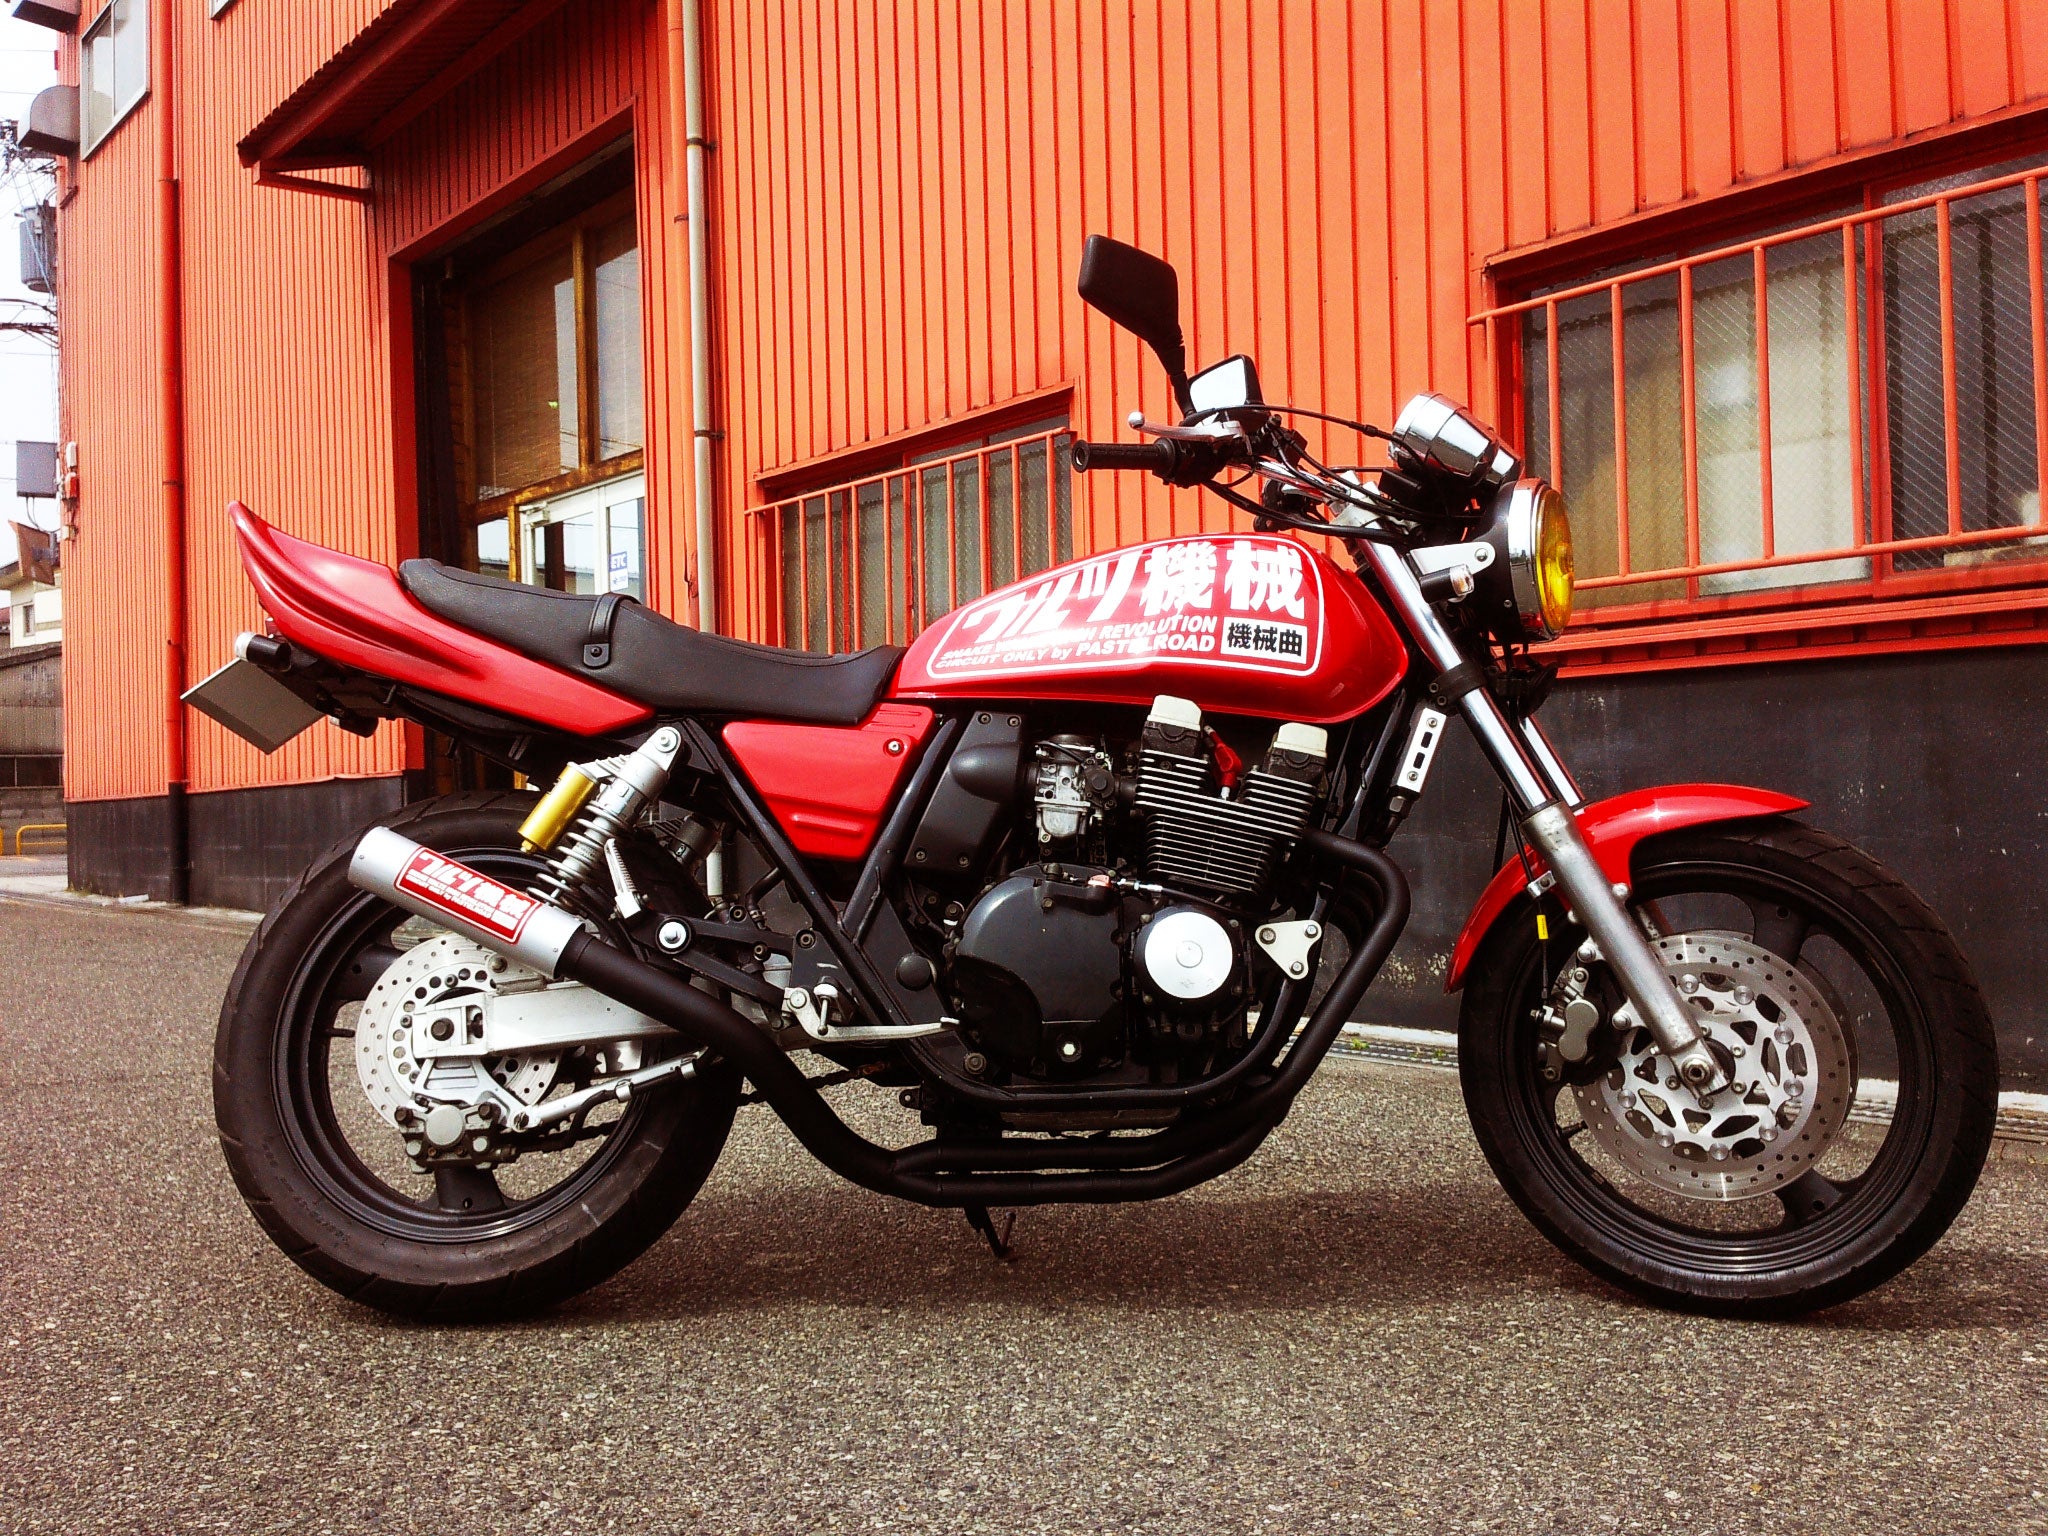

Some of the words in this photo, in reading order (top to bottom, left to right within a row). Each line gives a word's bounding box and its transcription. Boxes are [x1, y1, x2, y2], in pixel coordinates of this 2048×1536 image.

[1100, 615, 1217, 641] REVOLUTION
[1227, 622, 1302, 657] 機械曲
[935, 653, 1000, 669] CIRCUIT
[1002, 647, 1049, 663] ONLY
[1050, 646, 1073, 660] by
